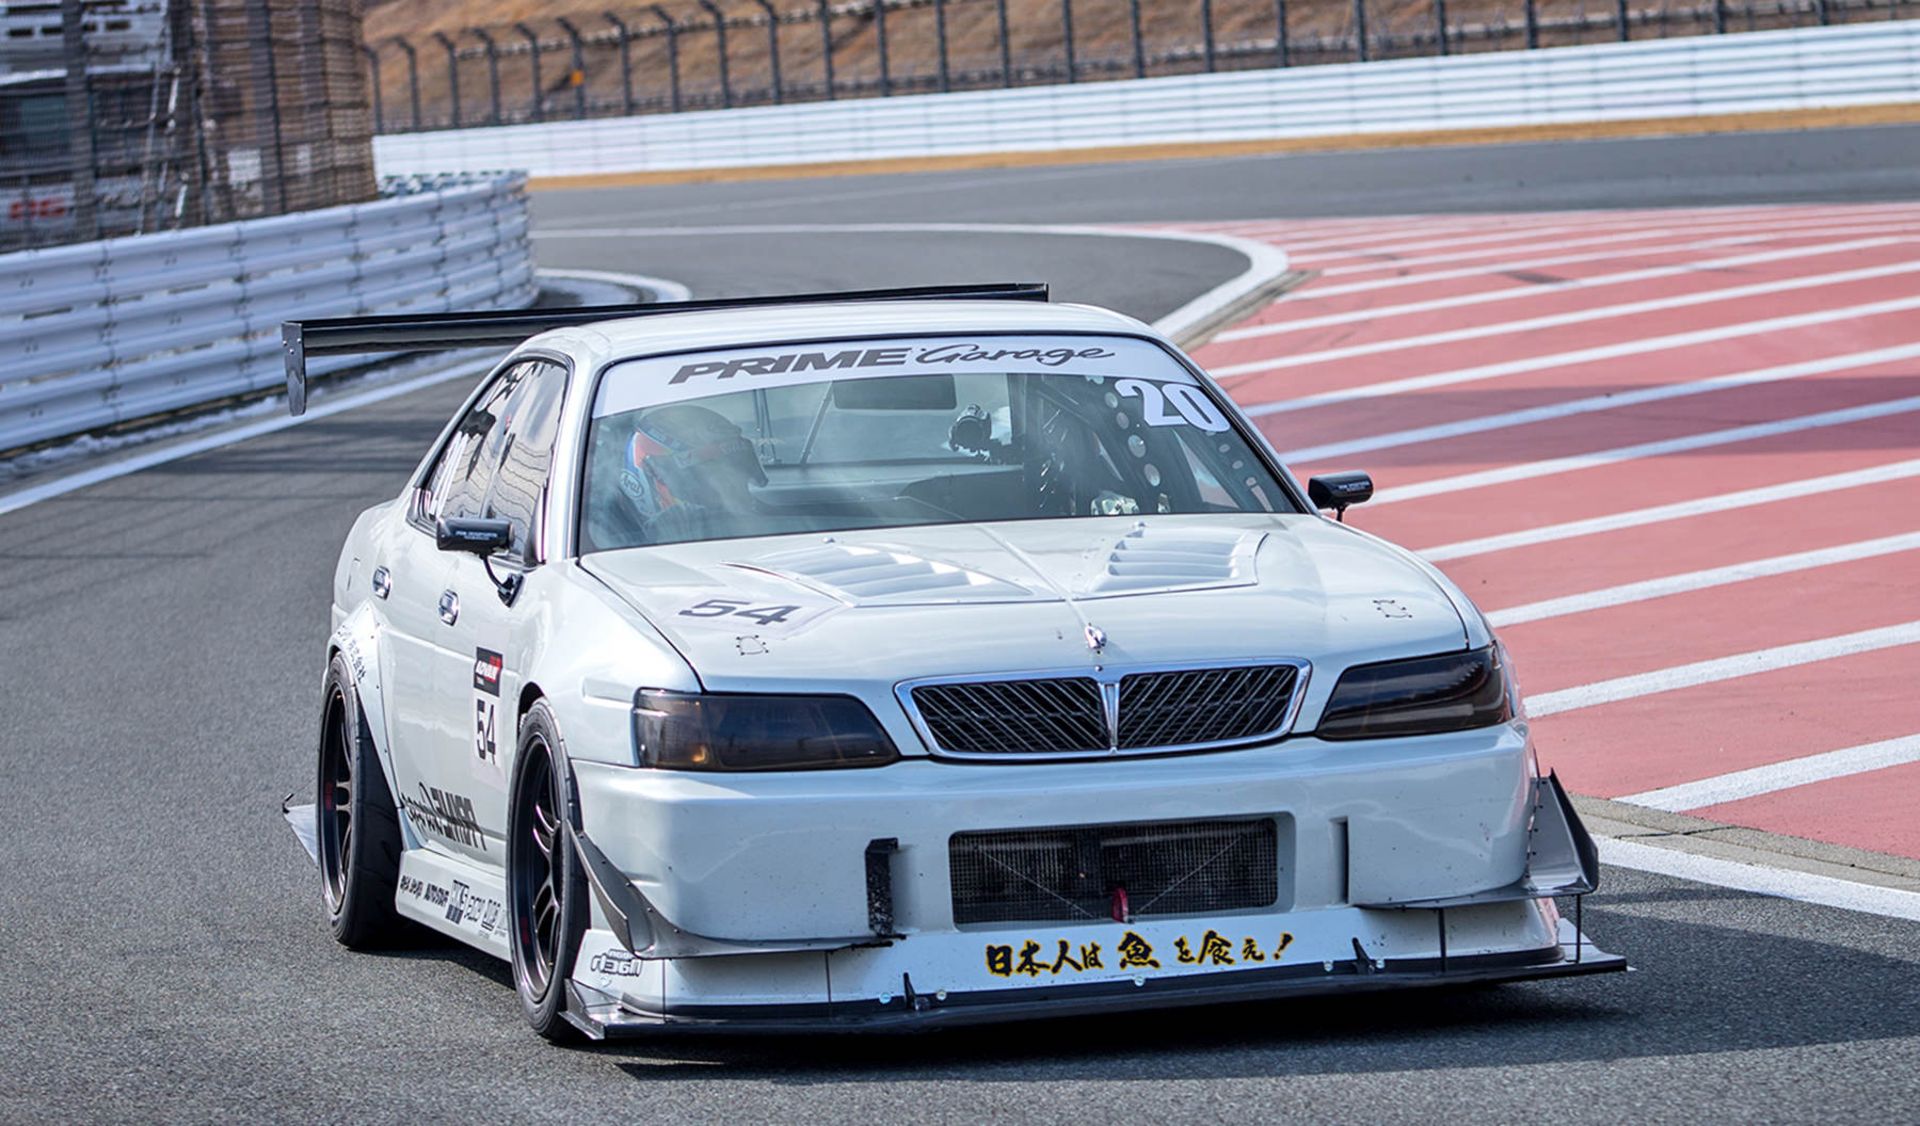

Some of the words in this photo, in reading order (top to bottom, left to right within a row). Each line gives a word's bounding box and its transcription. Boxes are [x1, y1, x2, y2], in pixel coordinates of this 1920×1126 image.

[667, 346, 912, 385] PRIME
[918, 343, 1115, 366] Garage
[1114, 379, 1230, 432] 20
[678, 599, 802, 625] 54
[476, 698, 496, 766] 54
